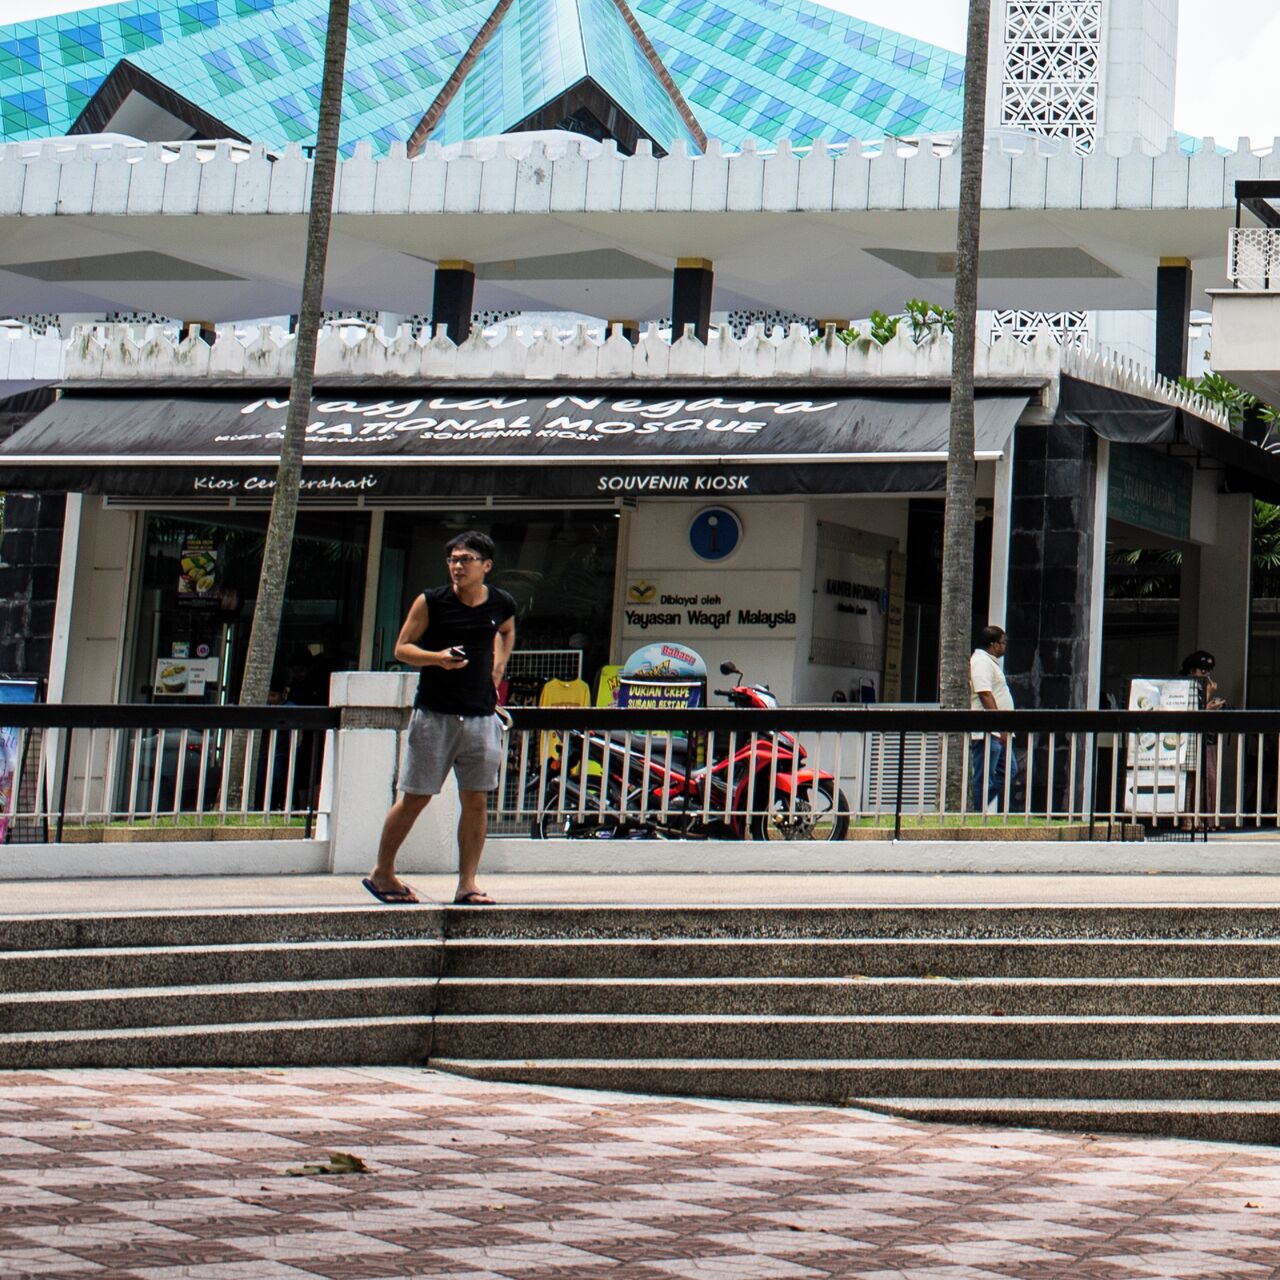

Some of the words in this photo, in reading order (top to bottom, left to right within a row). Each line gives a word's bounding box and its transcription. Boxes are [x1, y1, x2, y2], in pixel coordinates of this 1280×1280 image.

[545, 416, 767, 434] MOSQUE
[419, 429, 532, 440] SOUVENIR
[535, 429, 604, 442] KIOSK
[193, 476, 239, 490] Kios
[597, 475, 689, 490] SOUVENIR
[694, 475, 750, 490] KIOSK
[660, 594, 699, 607] Dibiayai
[700, 594, 721, 605] oleh
[625, 610, 681, 629] Yayasan
[687, 610, 732, 630] Waqaf
[738, 610, 797, 629] Malaysia
